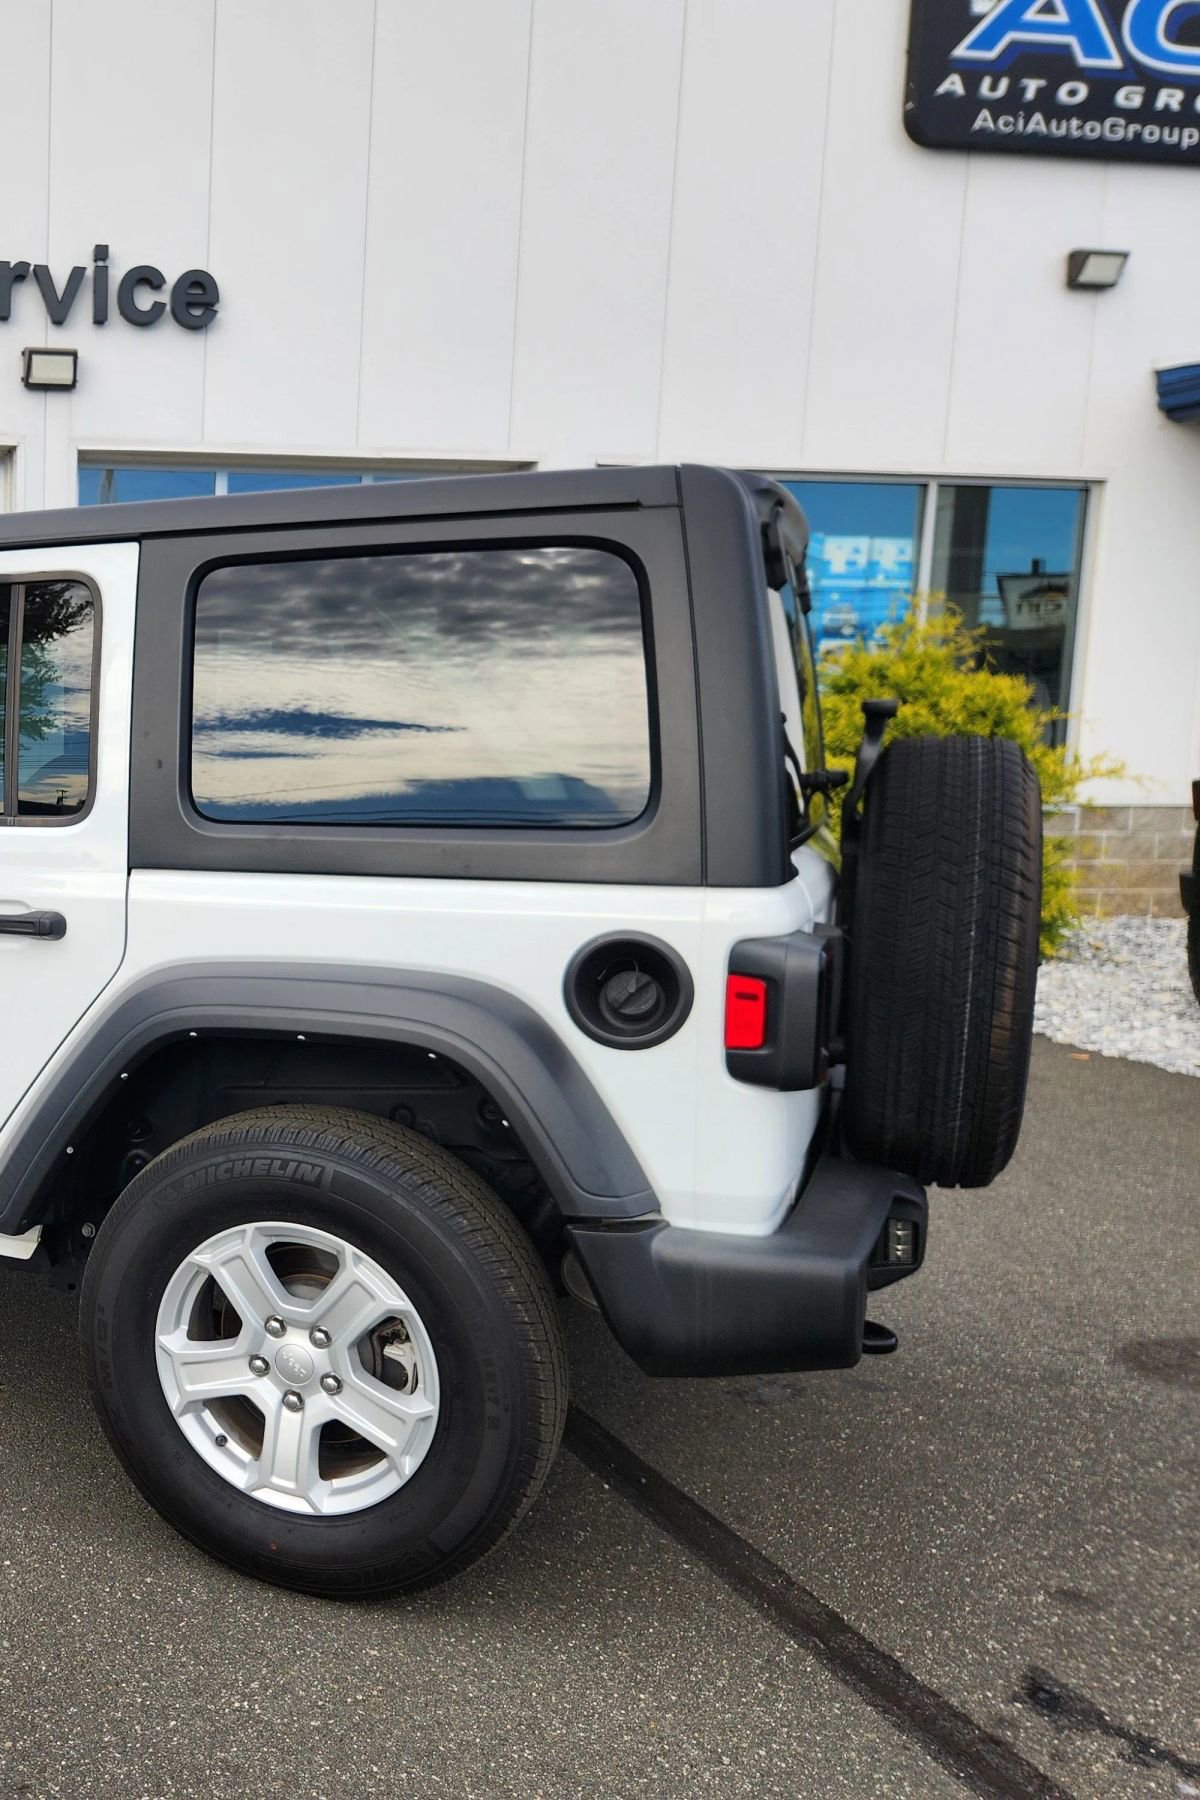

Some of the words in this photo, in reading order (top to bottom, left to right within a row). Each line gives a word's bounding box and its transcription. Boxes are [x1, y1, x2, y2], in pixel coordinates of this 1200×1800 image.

[934, 72, 1090, 106] AUTO
[1113, 84, 1200, 114] GR
[969, 107, 1200, 151] AciAutoGroup
[183, 1158, 324, 1193] MICHELIN
